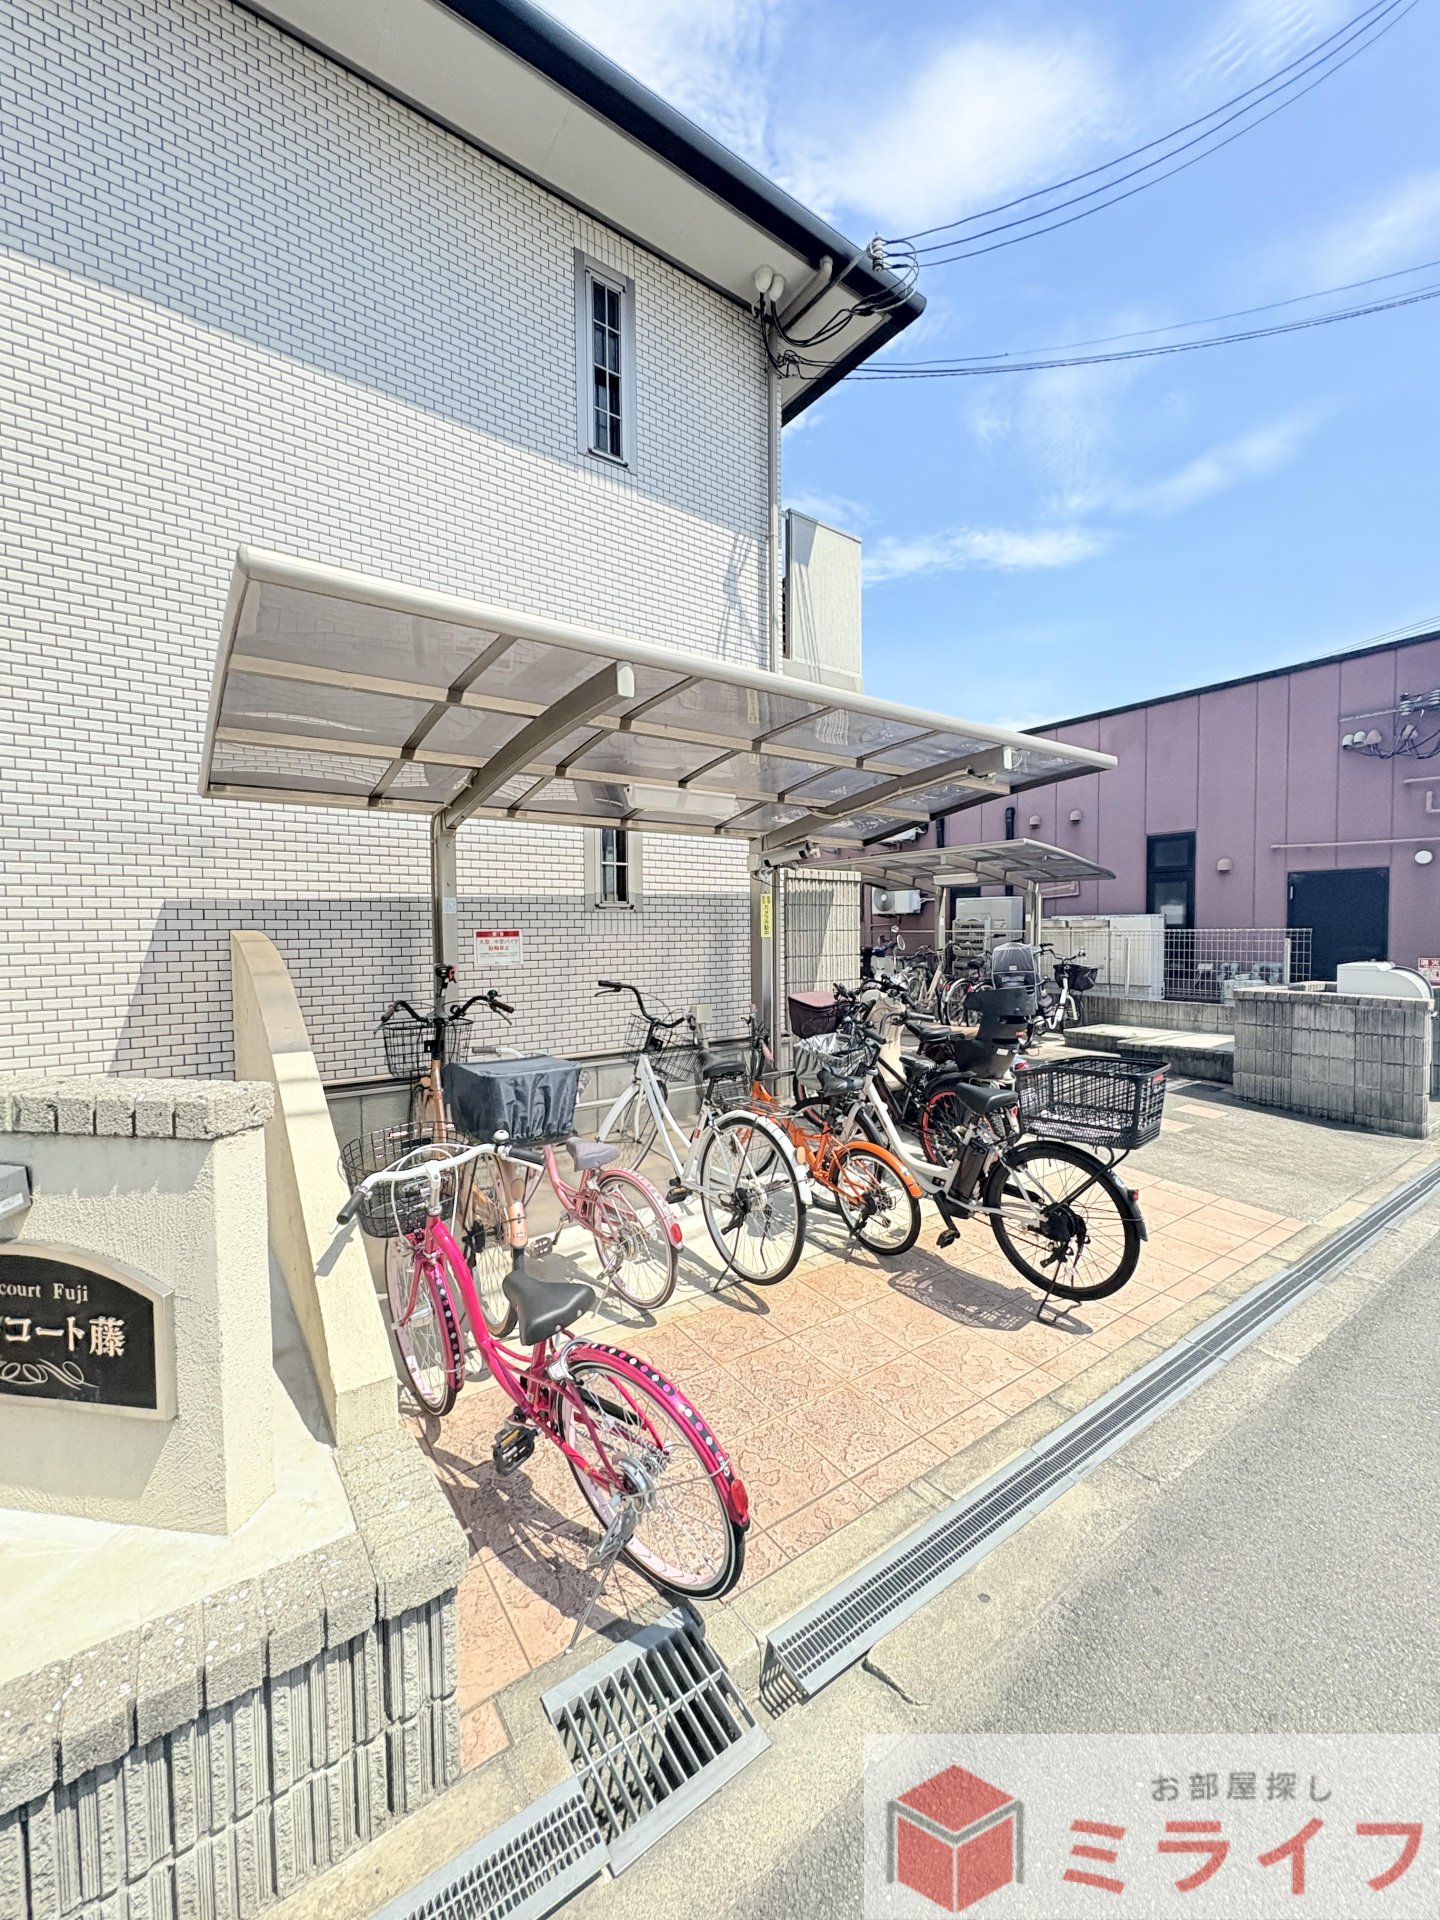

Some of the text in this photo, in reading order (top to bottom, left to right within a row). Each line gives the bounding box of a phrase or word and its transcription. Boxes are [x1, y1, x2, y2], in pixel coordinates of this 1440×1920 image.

[53, 1283, 89, 1305] Fuji
[0, 1315, 126, 1357] コート藤
